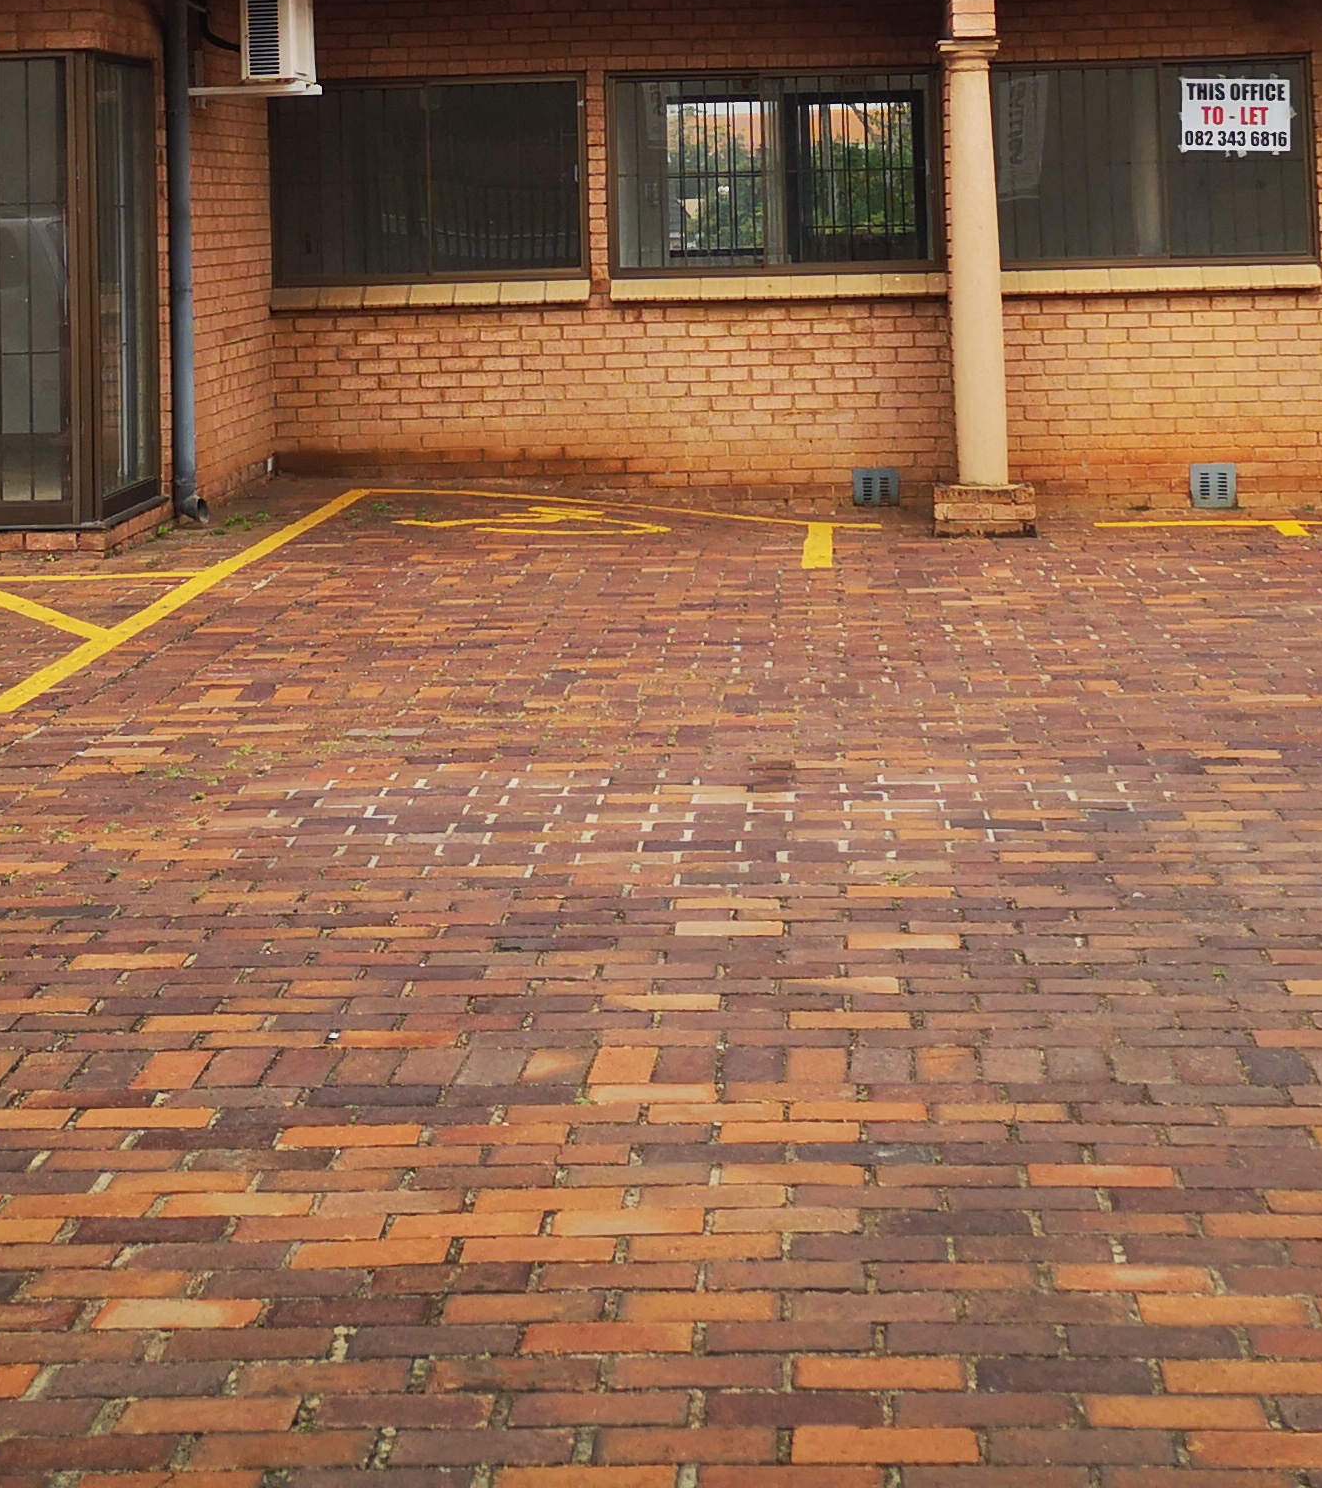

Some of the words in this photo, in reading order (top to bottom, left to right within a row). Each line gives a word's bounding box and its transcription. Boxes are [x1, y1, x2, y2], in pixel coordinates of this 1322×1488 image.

[1186, 83, 1225, 101] THIS
[1230, 83, 1286, 101] OFFICE
[1201, 106, 1224, 125] TO
[1240, 106, 1269, 125] LET
[1185, 130, 1213, 146] 082
[1217, 130, 1246, 147] 343
[1250, 131, 1287, 147] 6816
